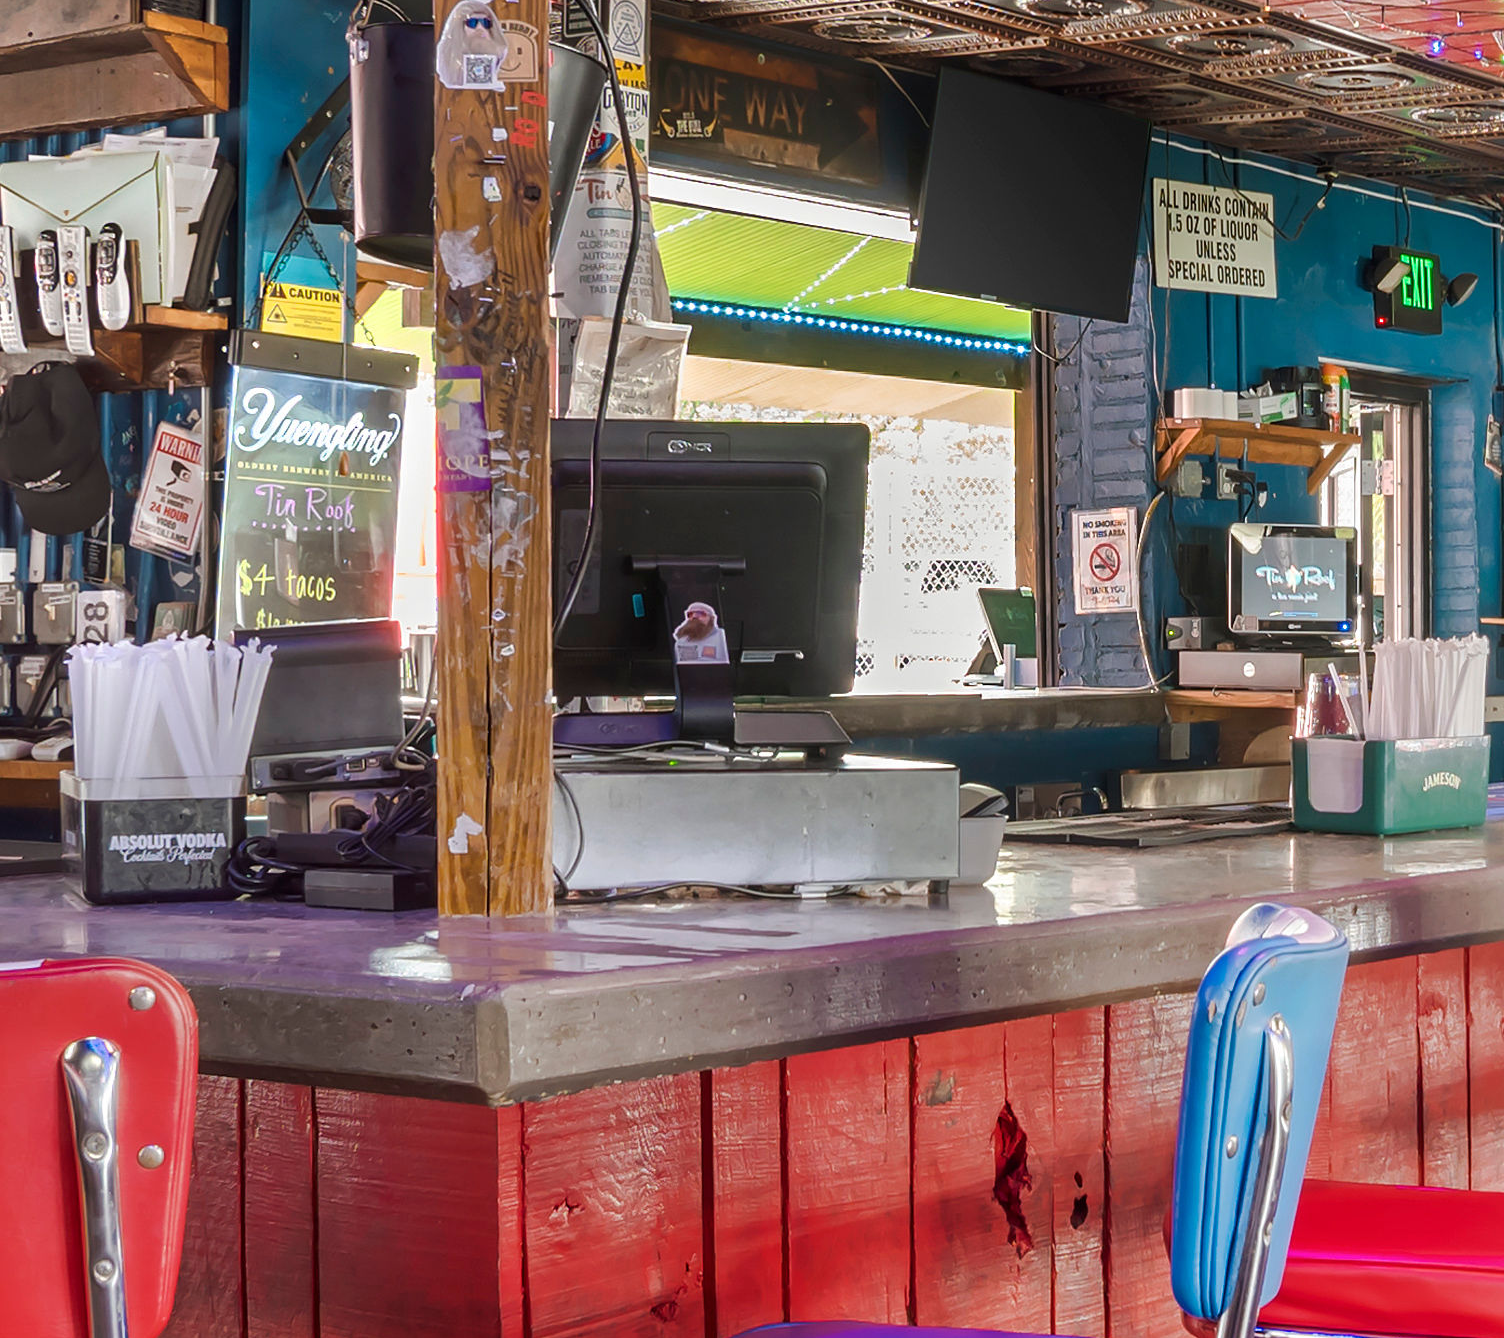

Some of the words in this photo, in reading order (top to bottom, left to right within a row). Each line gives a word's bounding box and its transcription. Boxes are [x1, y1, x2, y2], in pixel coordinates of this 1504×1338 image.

[664, 65, 732, 123] ONE
[747, 83, 809, 135] WAY
[576, 178, 612, 204] Tin
[1159, 188, 1178, 208] ALL
[1183, 191, 1221, 214] DRINKS
[1225, 196, 1269, 221] CONTAIN
[1168, 212, 1183, 231] 1.5
[1186, 214, 1200, 234] OZ
[1203, 216, 1217, 235] OF
[1220, 218, 1258, 241] LIQUOR
[1196, 239, 1236, 261] UNLESS
[1168, 259, 1214, 283] SPECIAL
[1217, 265, 1265, 287] ORDERED
[1400, 254, 1434, 310] EXIT
[289, 287, 340, 304] CAUTION
[233, 387, 401, 467] Yuengling
[350, 471, 393, 482] AMERICA
[149, 502, 161, 513] 24
[164, 506, 189, 524] HOUR
[255, 483, 296, 517] Tin
[305, 487, 355, 529] Roof
[1083, 520, 1094, 528] NO
[1083, 531, 1090, 539] IN
[1104, 529, 1126, 538] AREA
[238, 559, 275, 596] $4
[286, 569, 336, 601] tacos
[1085, 586, 1108, 595] THANK
[1109, 585, 1125, 594] YOU
[1256, 566, 1283, 585] Tin
[1303, 565, 1336, 590] Roof
[83, 601, 110, 643] 28
[1422, 768, 1462, 793] JAMESON
[109, 834, 173, 851] ABSOLUT
[176, 833, 226, 848] VODKA
